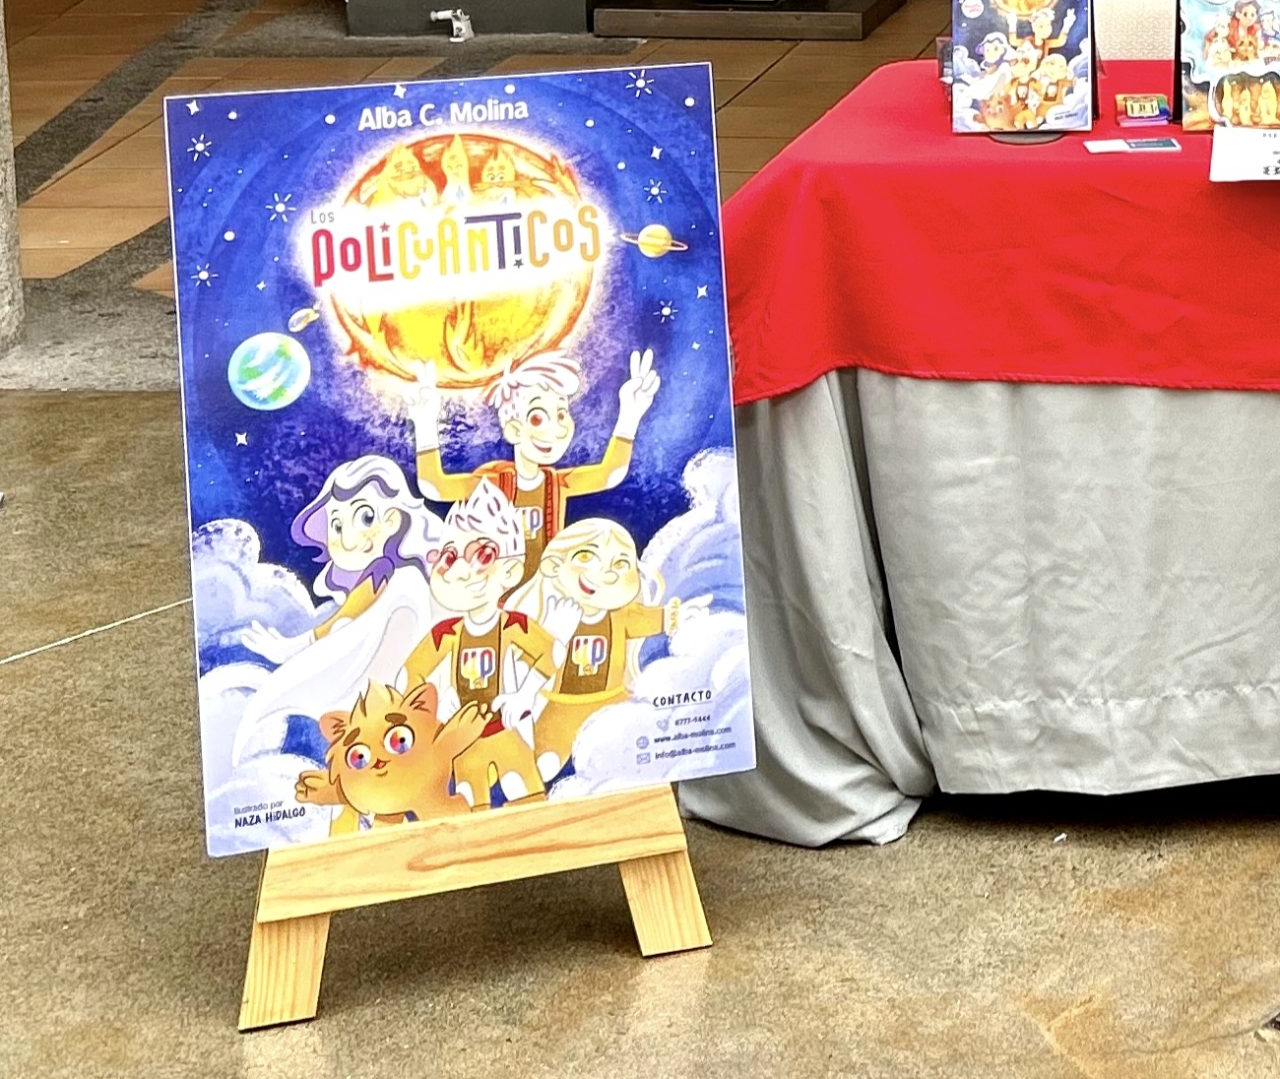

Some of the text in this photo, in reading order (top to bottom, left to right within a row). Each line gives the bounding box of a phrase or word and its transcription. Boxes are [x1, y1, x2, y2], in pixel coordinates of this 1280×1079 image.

[357, 98, 529, 131] Alba C. Molina
[310, 208, 335, 225] Los
[653, 689, 712, 707] CONTACTO
[270, 800, 284, 811] por
[234, 814, 261, 829] NAZA
